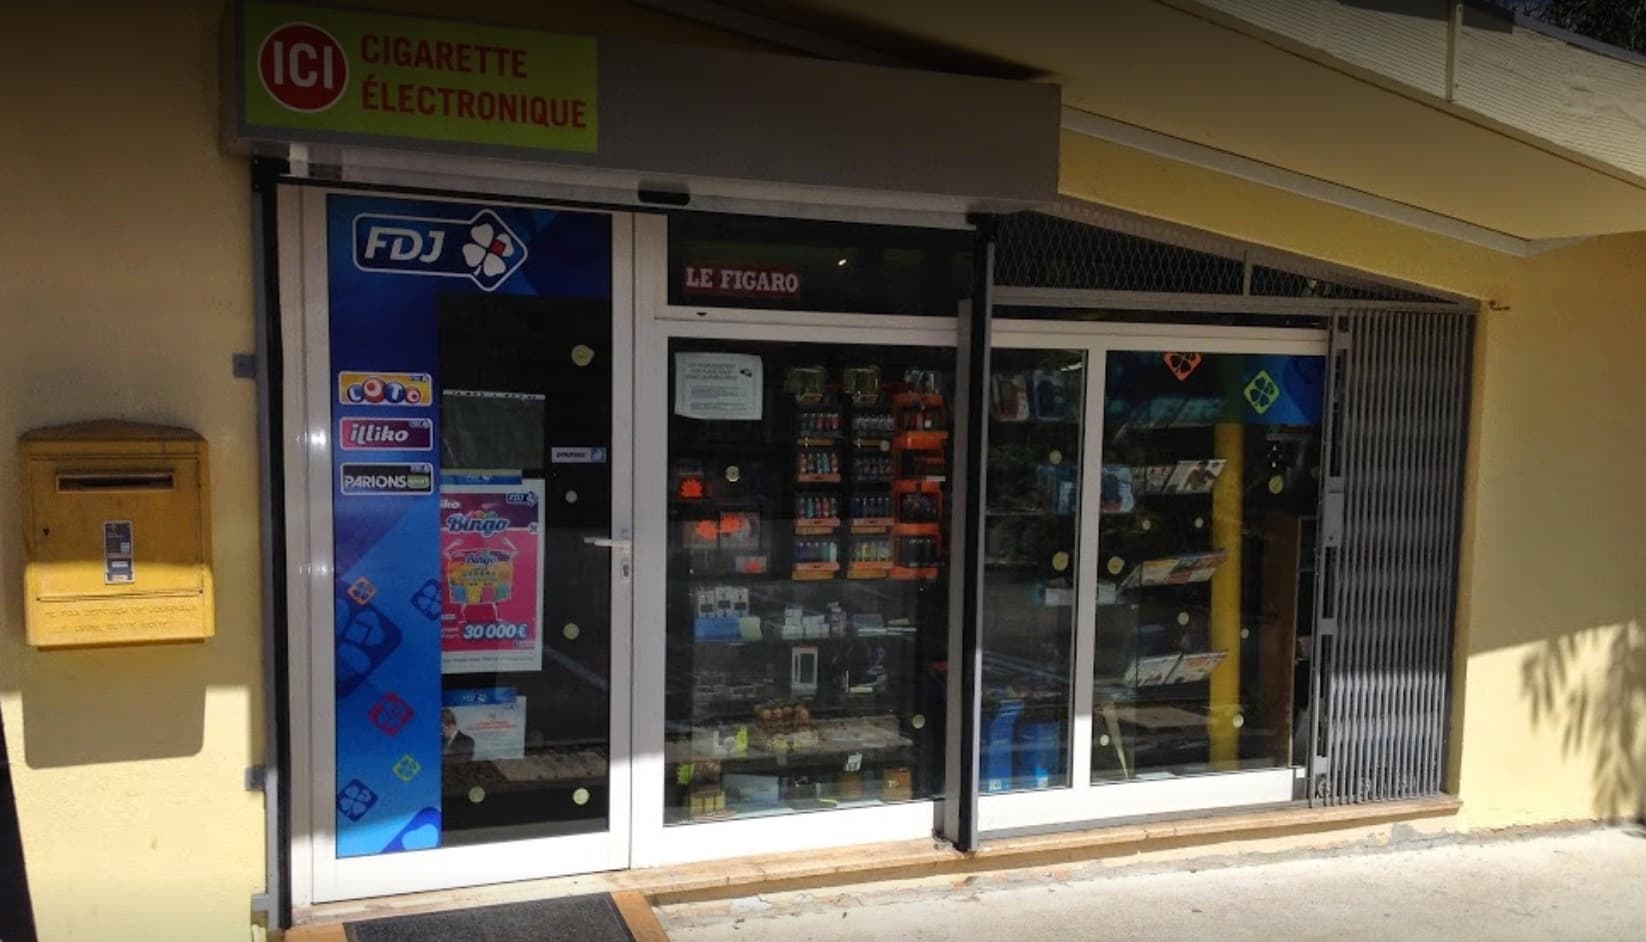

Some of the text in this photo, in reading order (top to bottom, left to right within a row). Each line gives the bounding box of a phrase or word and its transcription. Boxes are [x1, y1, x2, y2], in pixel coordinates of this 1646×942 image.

[272, 39, 334, 90] ICI
[360, 33, 528, 79] CIGARETTE
[361, 76, 587, 129] ÉLECTRONIQUE
[364, 226, 445, 263] FDJ
[685, 266, 799, 294] LE FIGARO
[350, 423, 409, 444] illiko
[344, 475, 407, 489] PARIONS
[448, 514, 510, 536] Bingo
[463, 624, 484, 639] 30
[485, 623, 517, 639] 000
[518, 623, 528, 638] €
